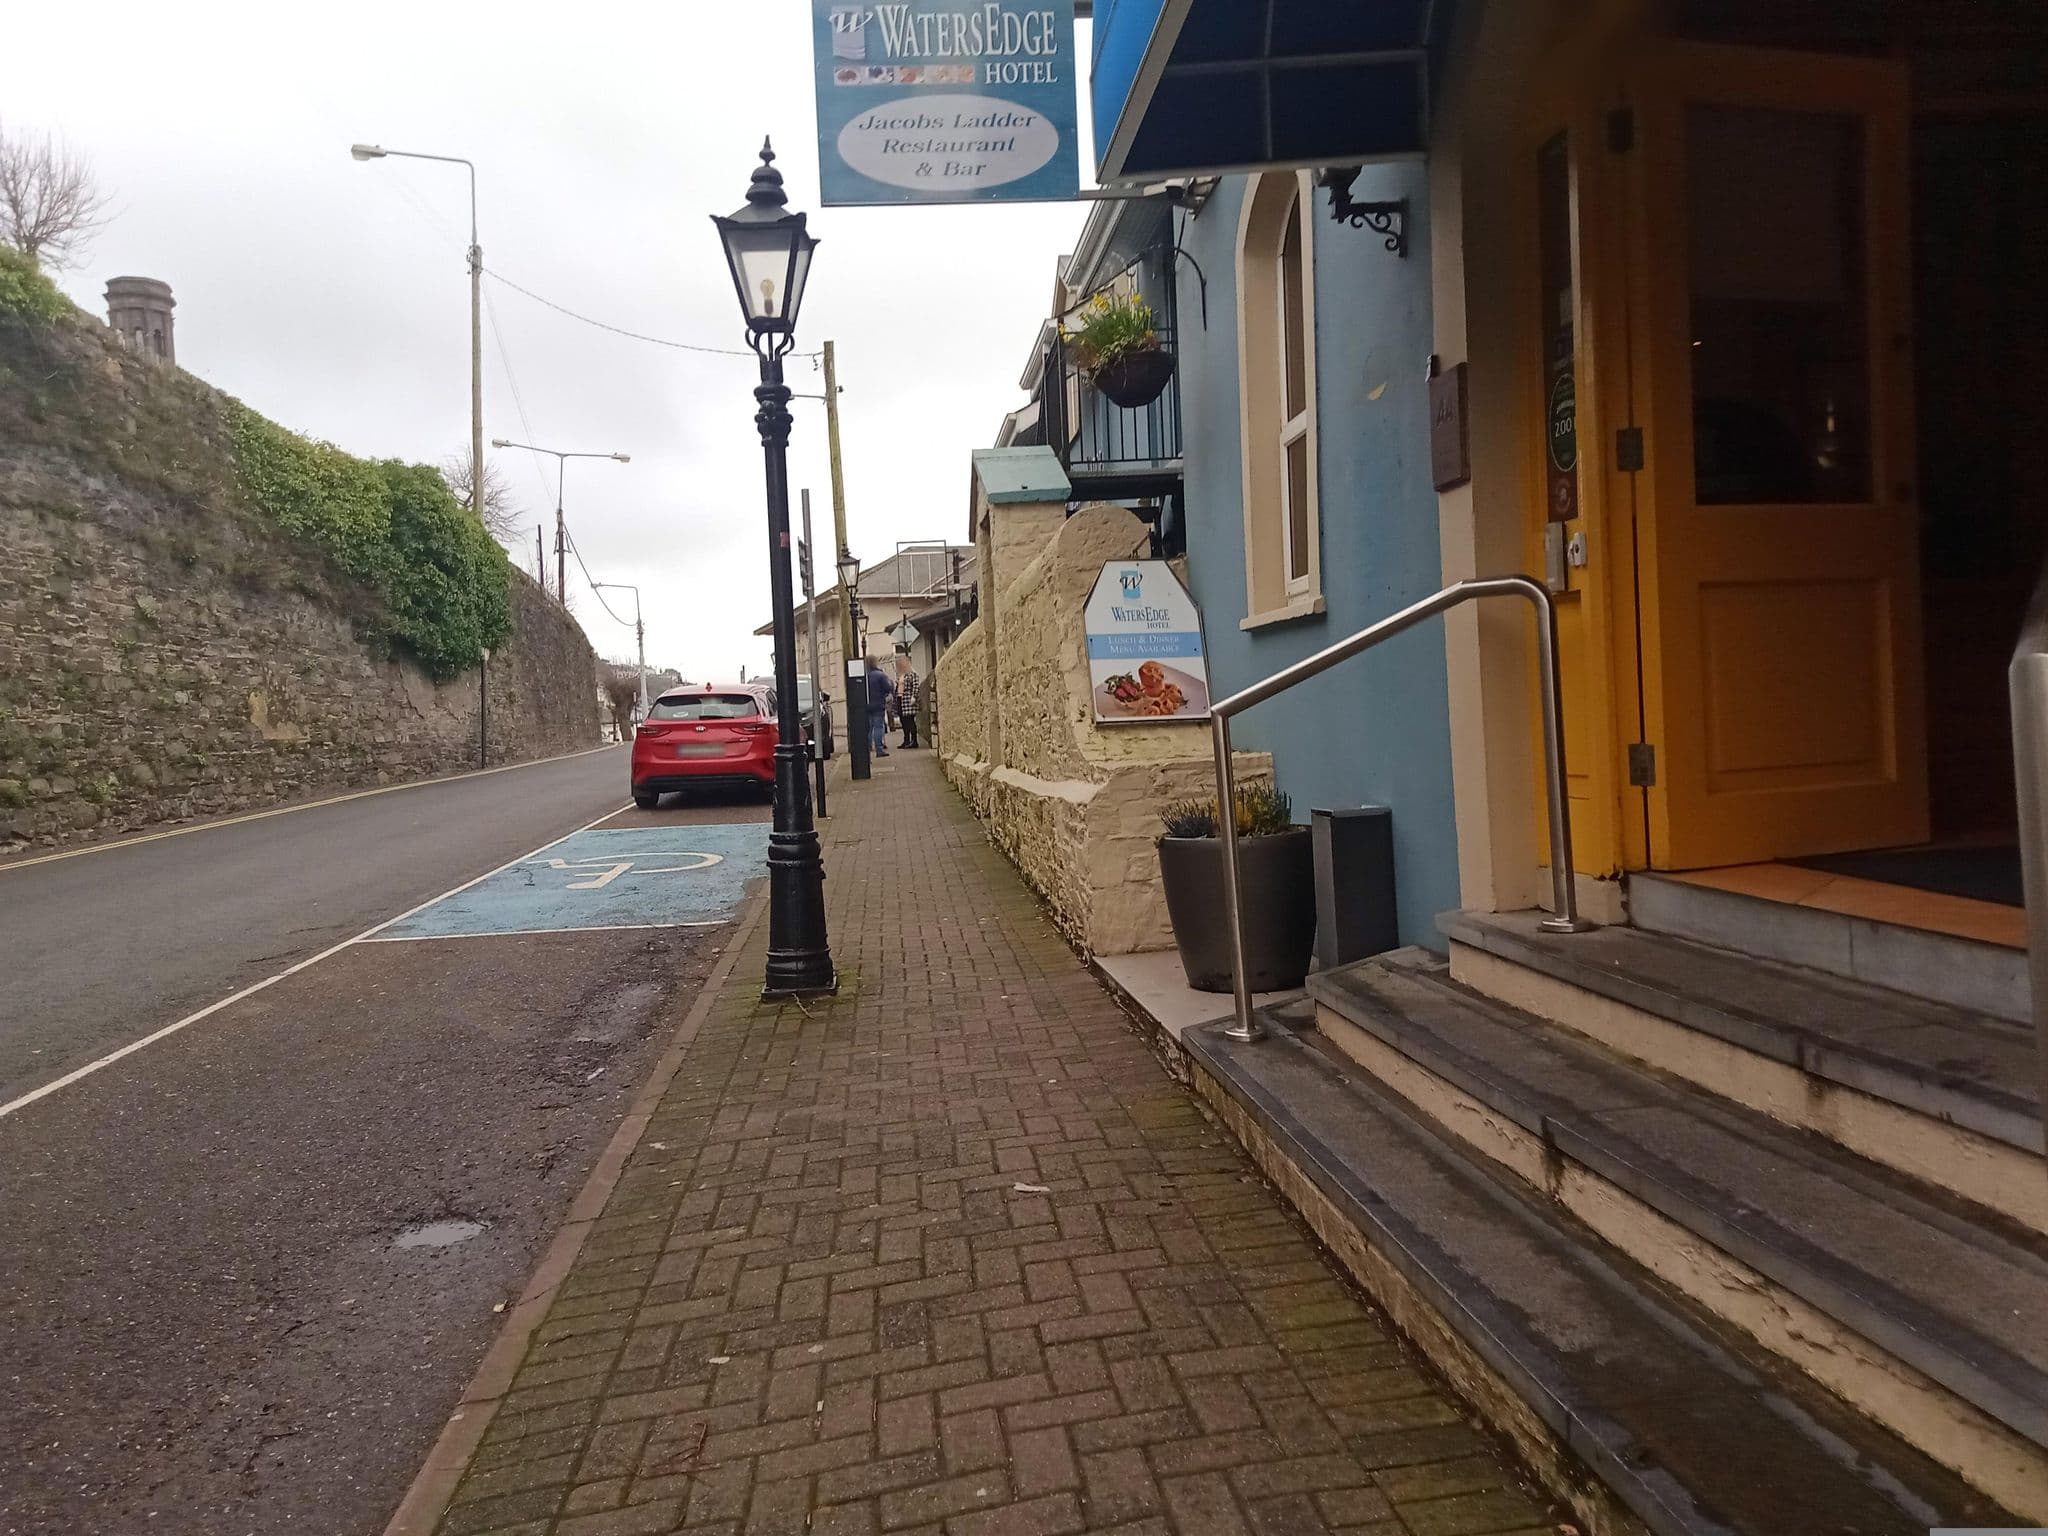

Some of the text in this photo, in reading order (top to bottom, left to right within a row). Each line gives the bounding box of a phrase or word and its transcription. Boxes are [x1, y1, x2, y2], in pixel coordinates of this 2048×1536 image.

[985, 62, 1058, 84] HOTEL
[858, 112, 1037, 130] Jacobs Ladder
[882, 136, 1015, 154] Restaurant
[914, 161, 988, 177] & Bar
